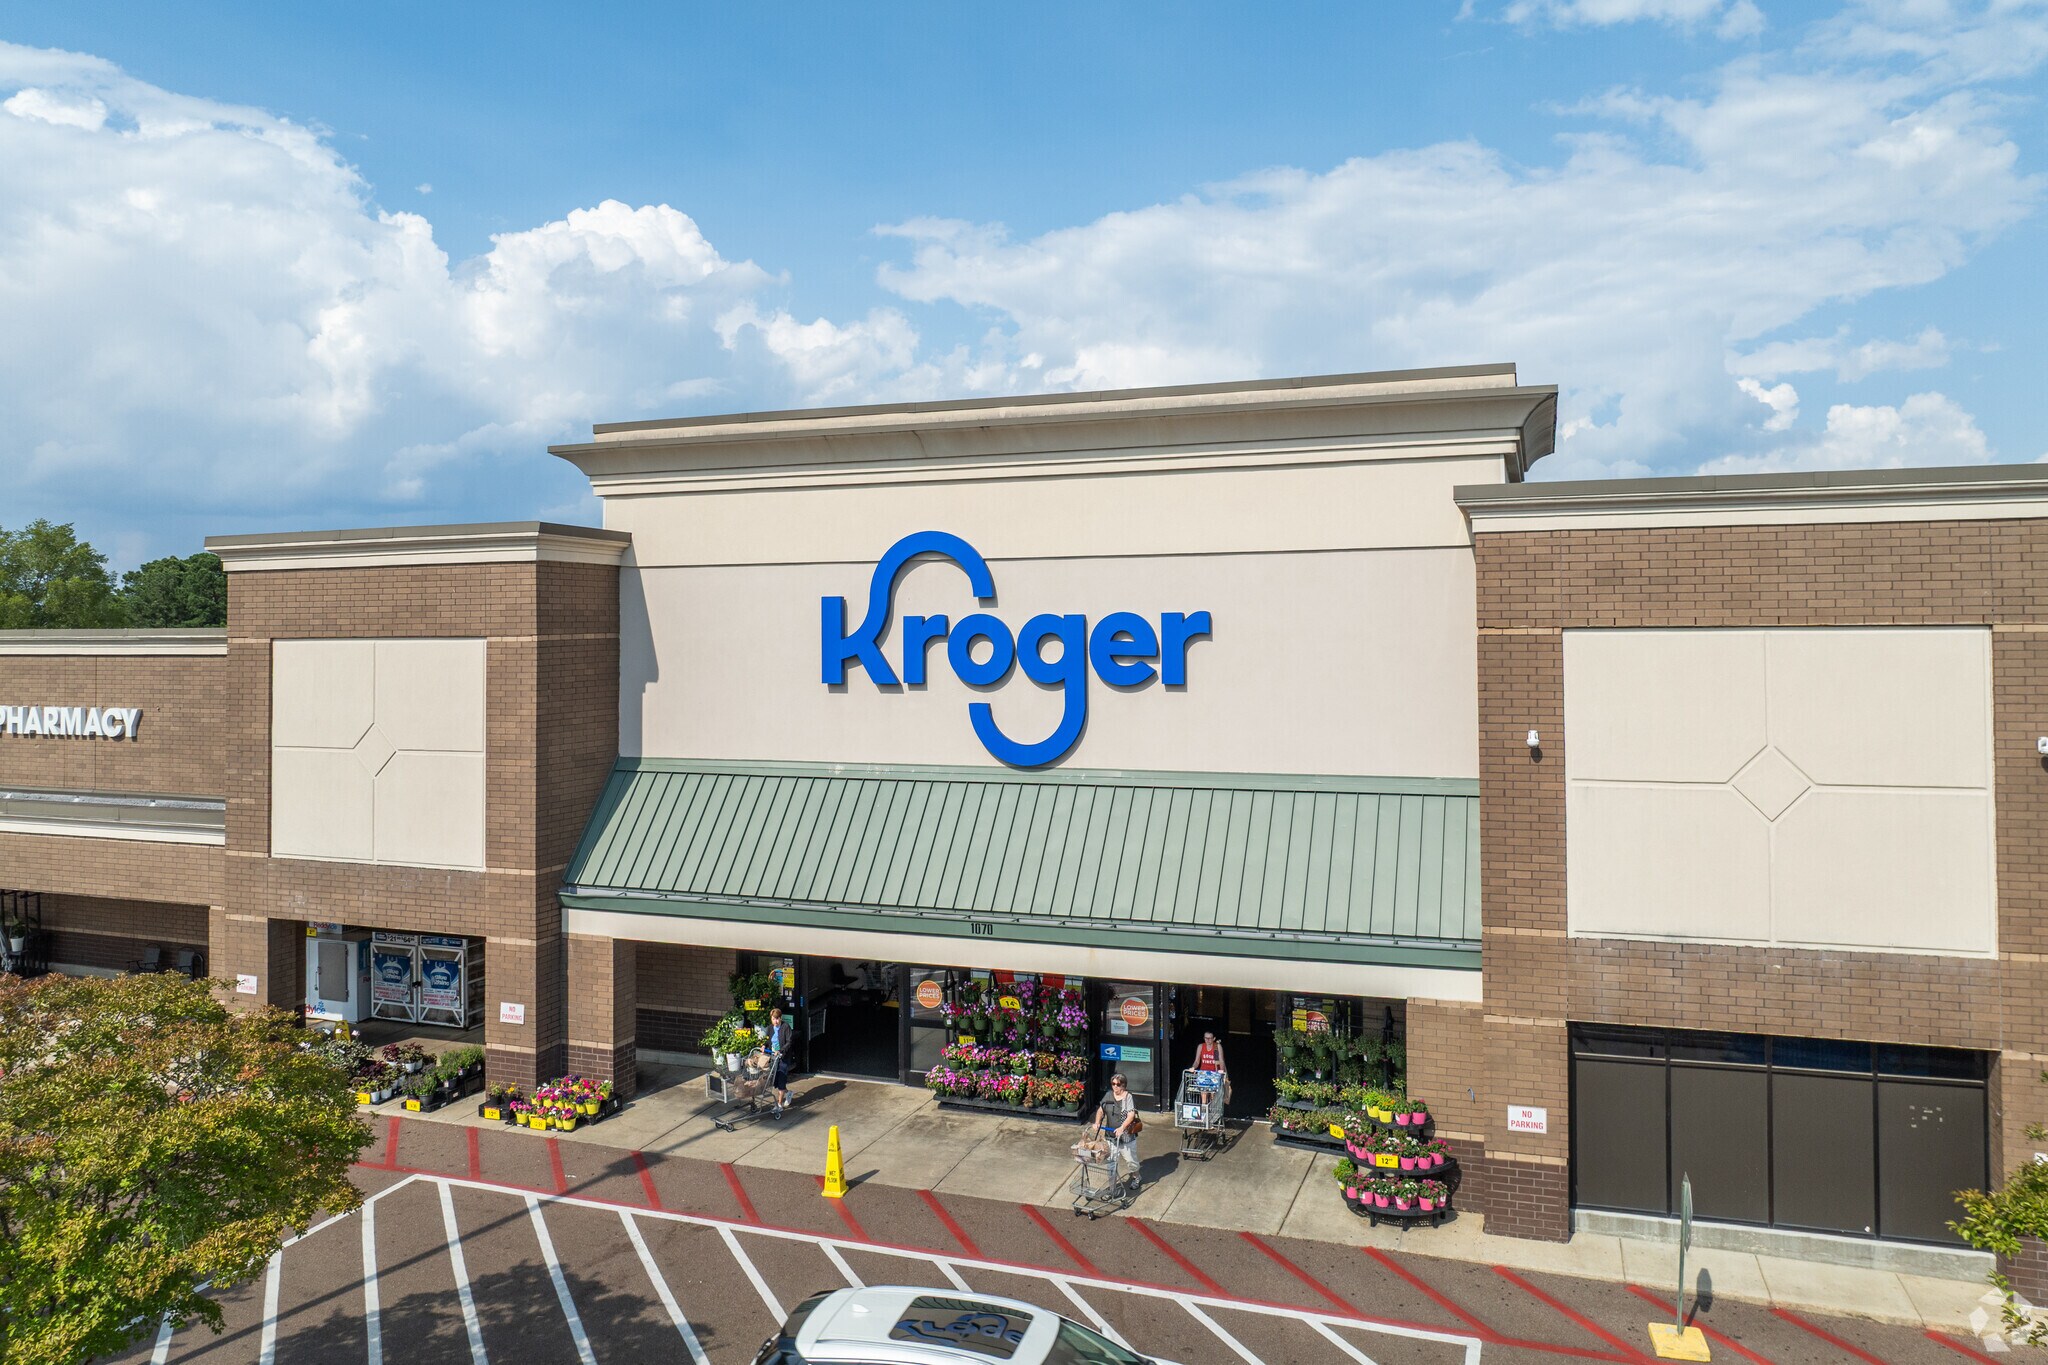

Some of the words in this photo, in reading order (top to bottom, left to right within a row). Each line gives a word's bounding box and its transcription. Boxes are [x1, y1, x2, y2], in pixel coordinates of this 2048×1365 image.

[821, 530, 1211, 767] Kroger
[971, 923, 993, 935] 1070
[501, 1013, 523, 1021] PARKING
[1522, 1110, 1532, 1118] NO
[1511, 1120, 1544, 1130] PARKING
